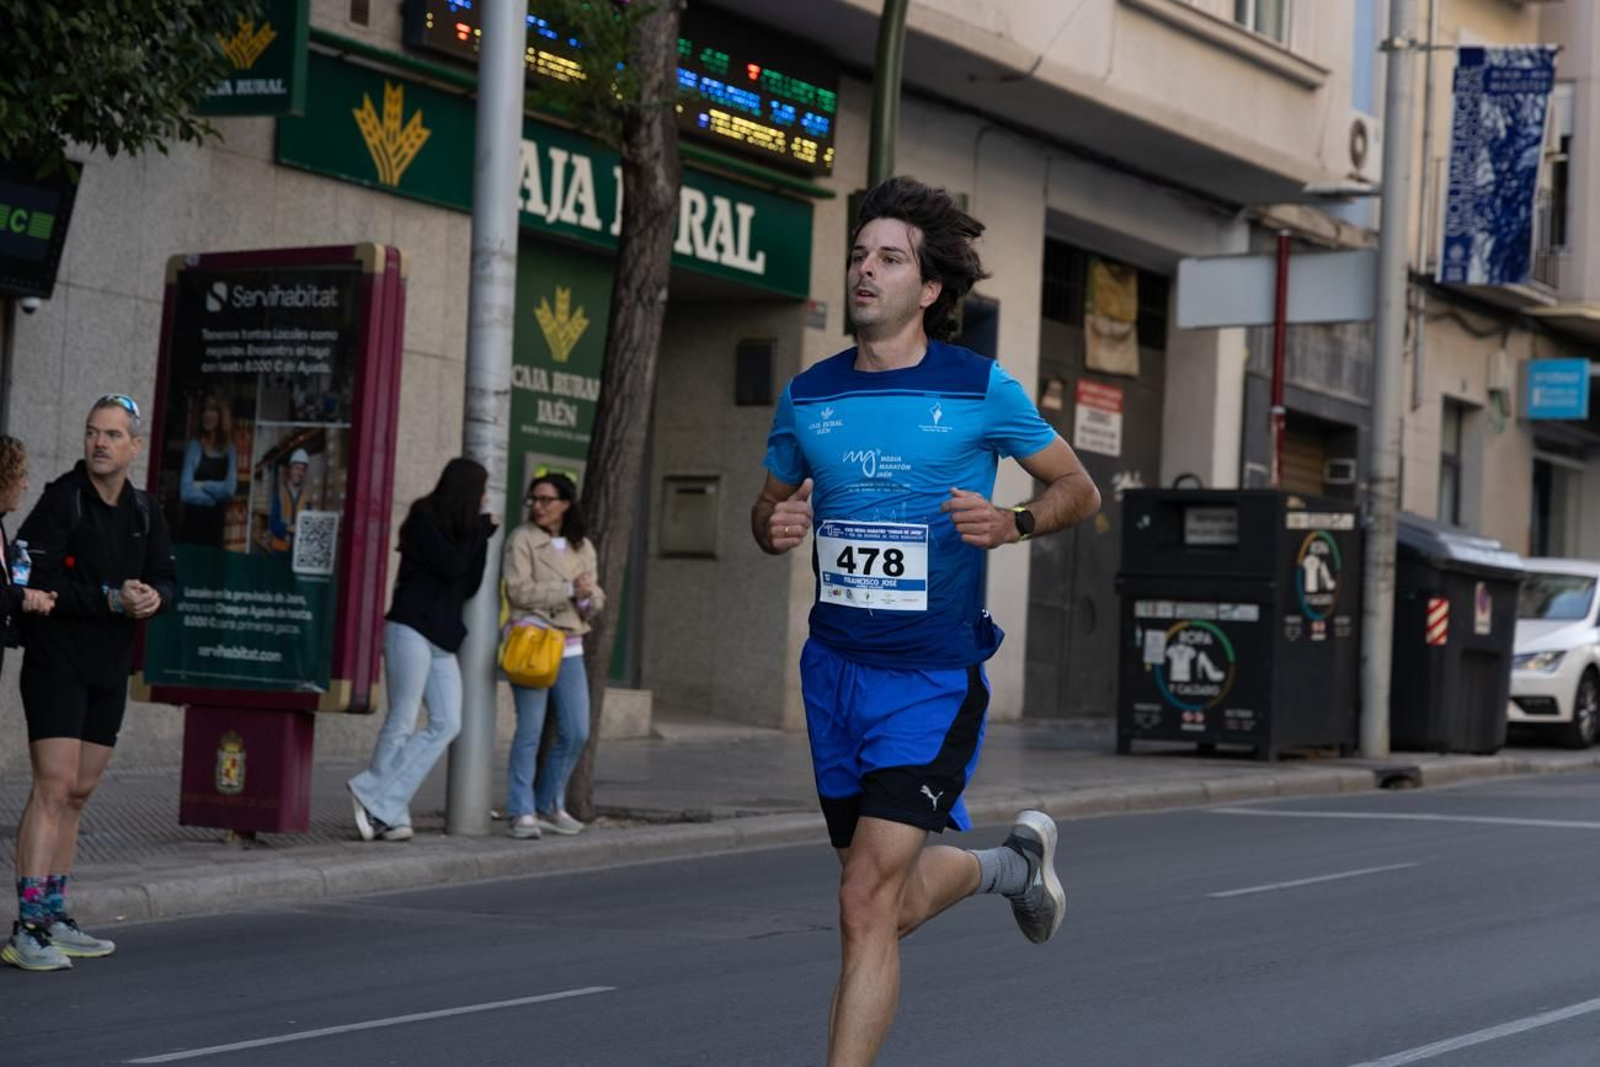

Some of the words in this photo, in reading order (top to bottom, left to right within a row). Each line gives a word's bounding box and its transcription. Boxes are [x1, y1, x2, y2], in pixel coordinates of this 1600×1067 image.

[236, 78, 287, 95] RURAL
[518, 139, 602, 232] AJA
[612, 166, 767, 276] RAL
[232, 284, 339, 308] Servihabitat
[511, 364, 550, 393] CAJA
[837, 546, 905, 577] 478
[843, 577, 880, 586] FRANCISCO
[881, 578, 898, 588] JOSÉ
